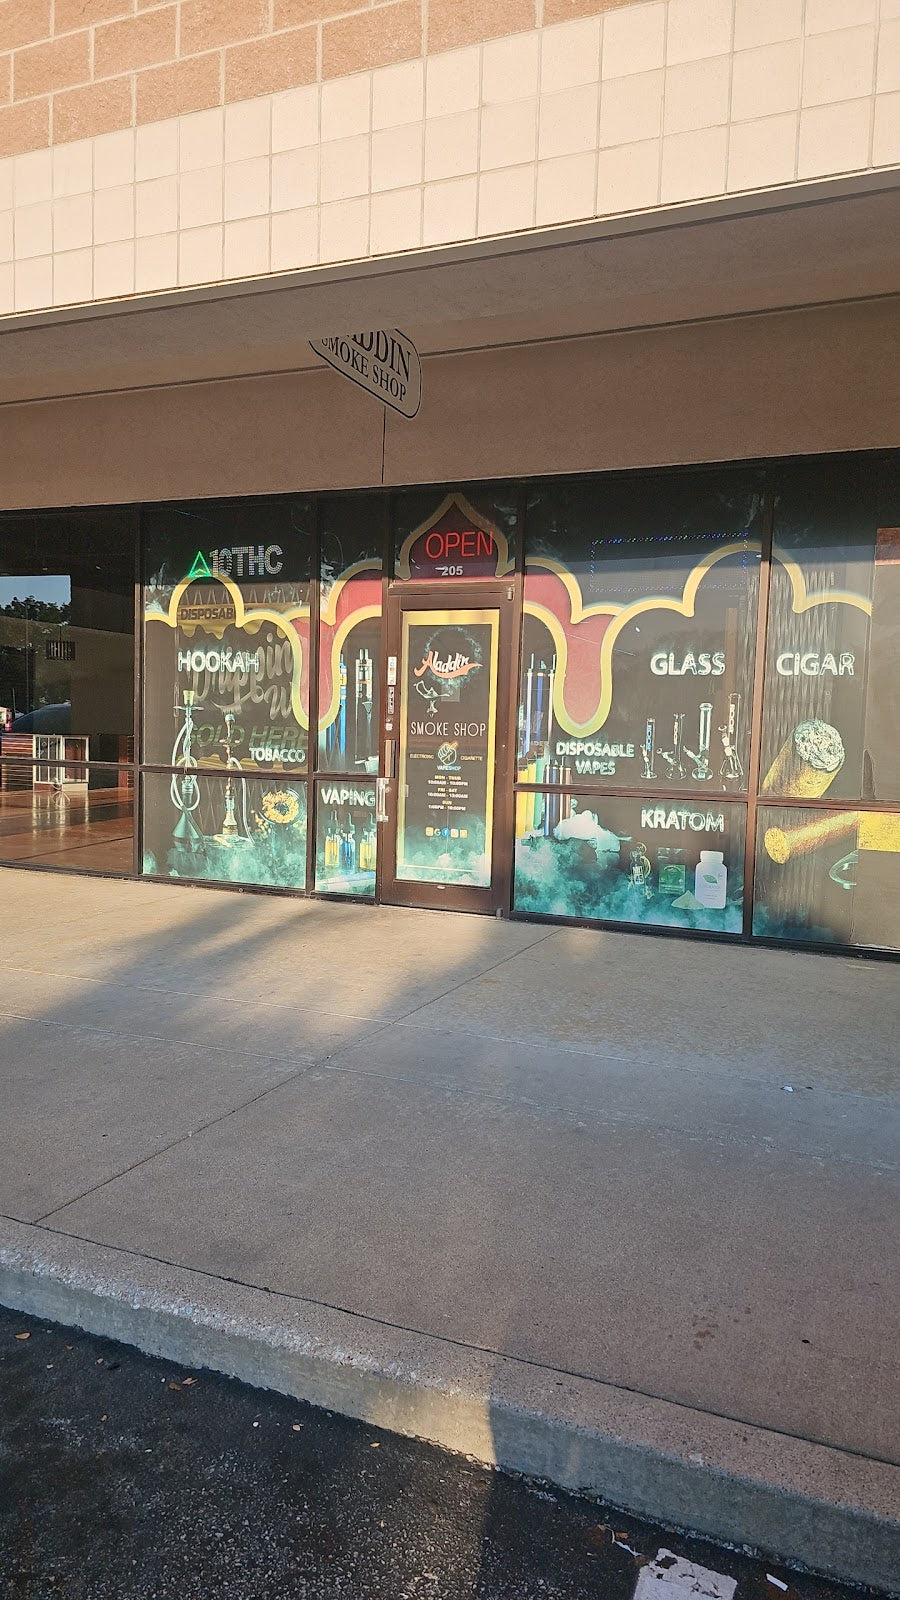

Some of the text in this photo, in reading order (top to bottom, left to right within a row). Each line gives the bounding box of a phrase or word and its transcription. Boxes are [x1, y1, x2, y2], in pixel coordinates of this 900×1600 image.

[346, 330, 411, 382] DDIN
[373, 364, 406, 402] SHOP
[426, 530, 494, 559] OPEN
[441, 565, 464, 577] 205
[181, 608, 252, 620] DISPOSAB
[177, 650, 260, 673] HOOKAH
[414, 650, 483, 678] Aladdin
[650, 652, 725, 676] GLASS
[776, 652, 855, 676] CIGAR
[411, 722, 486, 737] SMOKE SHOP
[249, 747, 306, 763] TOBACCO
[556, 741, 635, 758] DISPOSABLE
[575, 760, 616, 776] VAPES
[321, 788, 375, 807] VAPING
[641, 809, 725, 833] KRATOM
